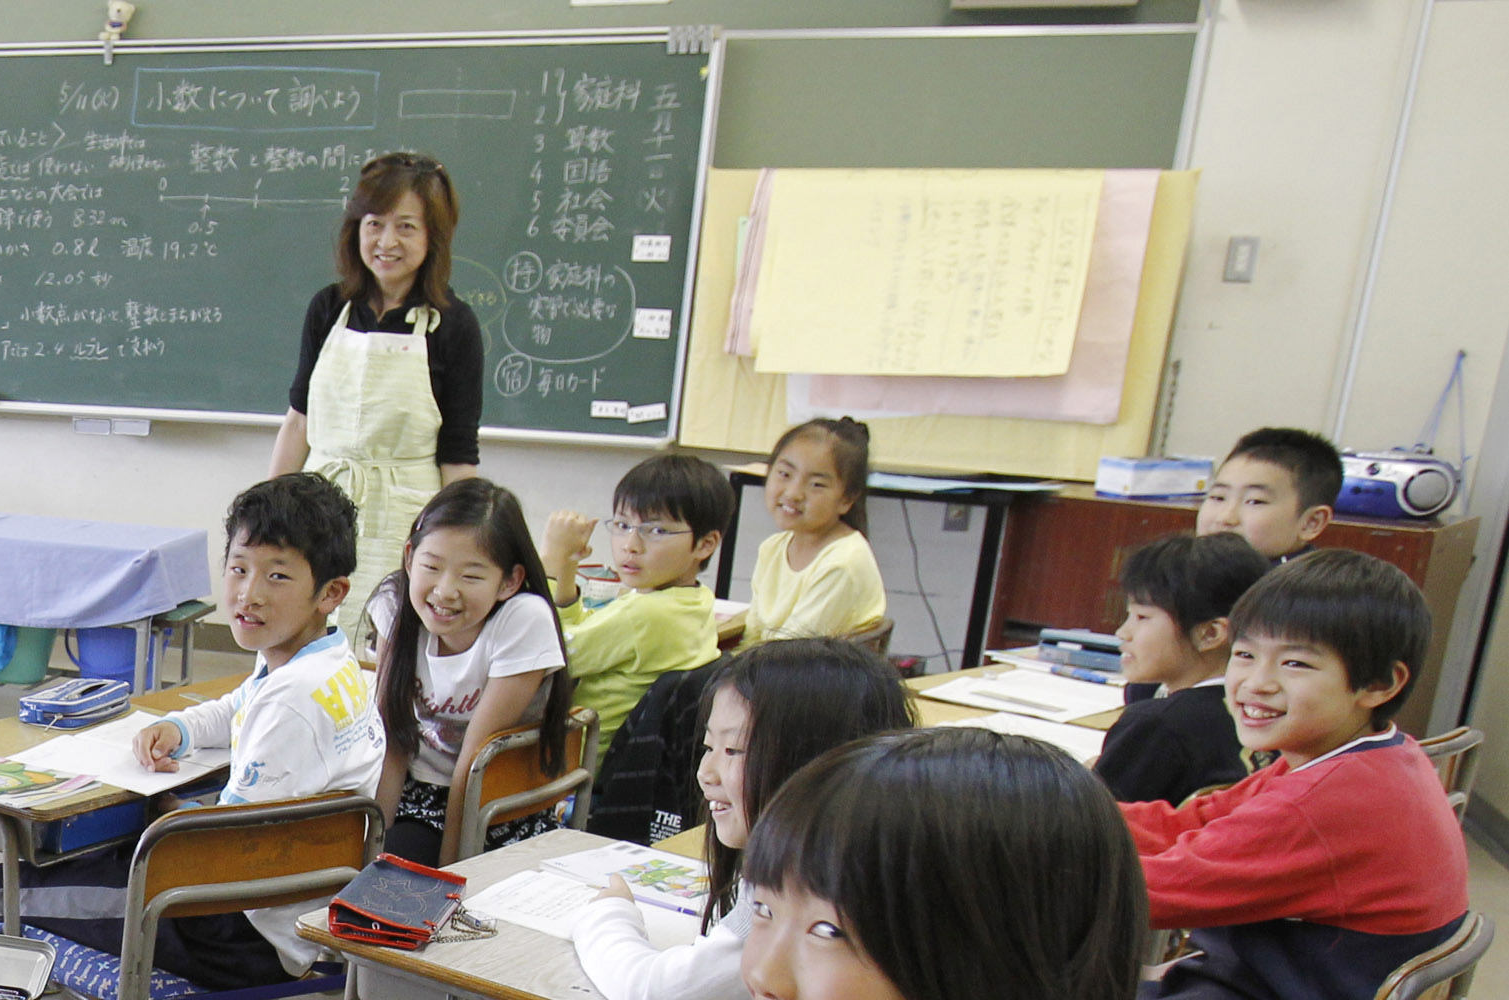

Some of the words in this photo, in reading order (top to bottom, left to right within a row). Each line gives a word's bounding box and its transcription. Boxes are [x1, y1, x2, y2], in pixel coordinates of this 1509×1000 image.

[147, 76, 361, 121] 小数について調べよう
[573, 72, 642, 112] 家庭科
[534, 134, 545, 153] 3
[563, 125, 616, 154] 算数
[158, 176, 168, 191] 0
[339, 176, 350, 192] 2
[563, 157, 613, 184] 国語
[531, 190, 542, 212] 5
[556, 186, 614, 213] 社会
[187, 221, 219, 235] 0.5
[527, 215, 540, 237] 6
[552, 213, 616, 243] 委員会
[655, 810, 683, 828] THE
